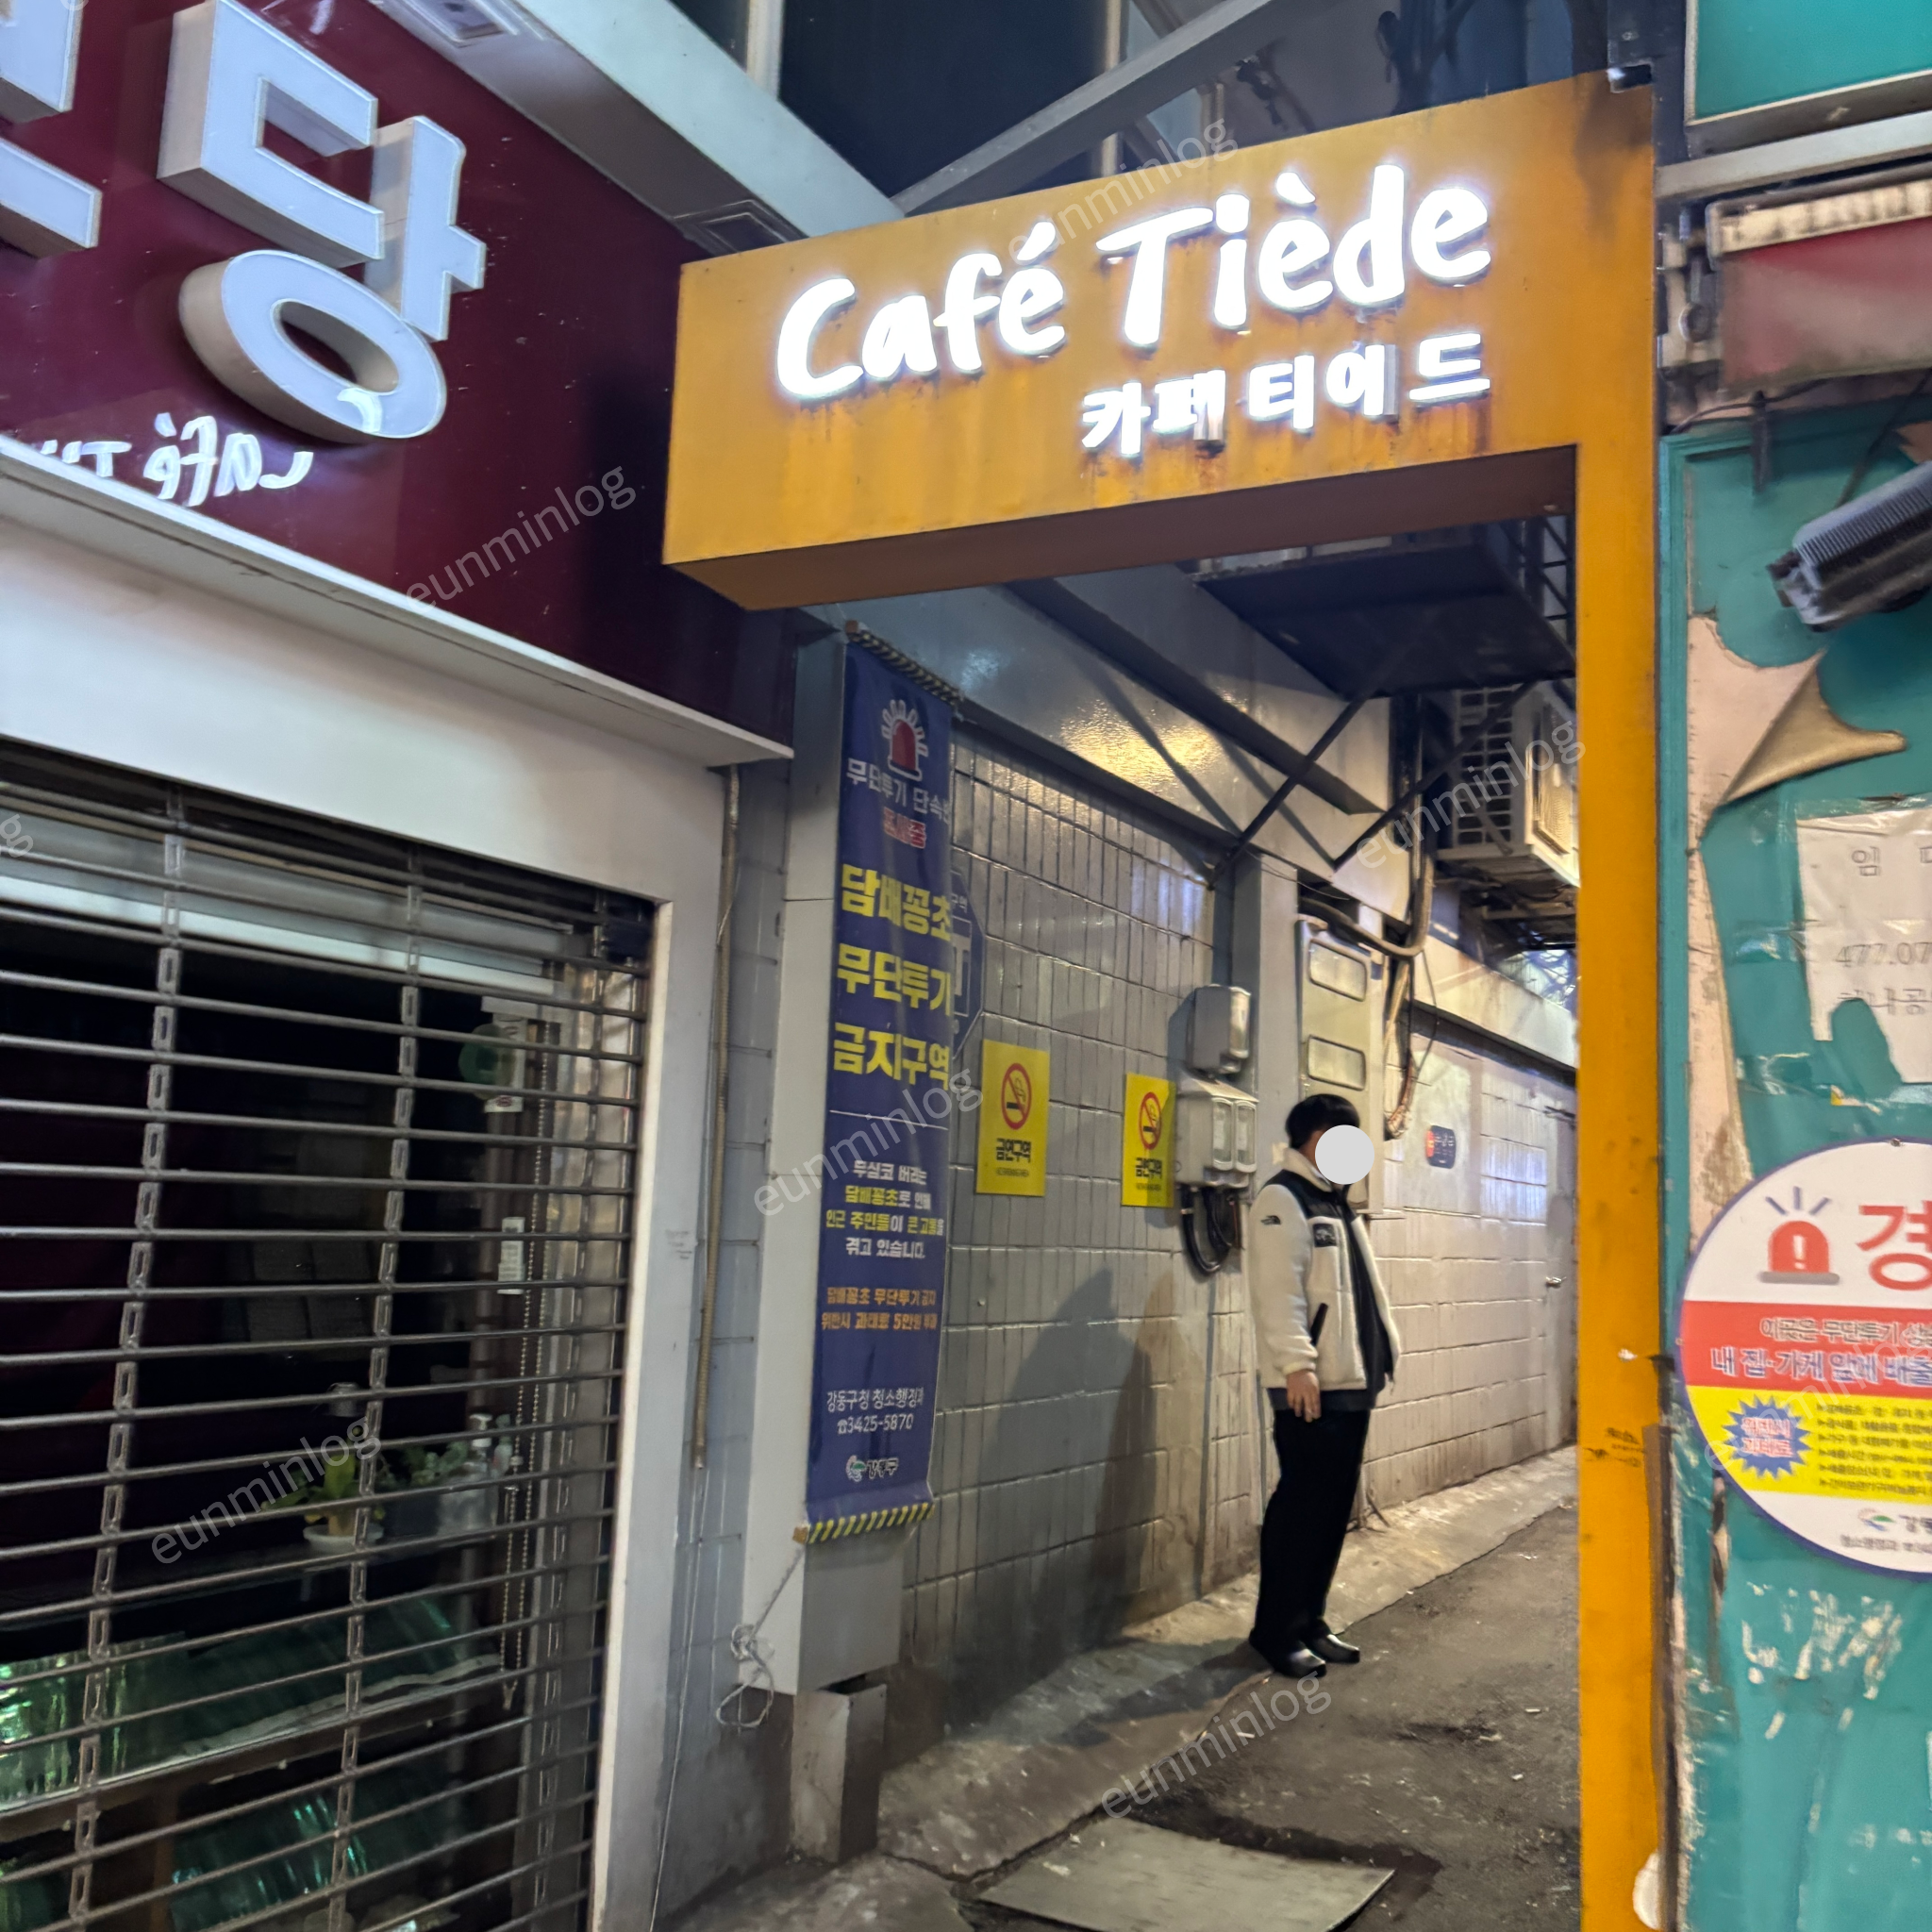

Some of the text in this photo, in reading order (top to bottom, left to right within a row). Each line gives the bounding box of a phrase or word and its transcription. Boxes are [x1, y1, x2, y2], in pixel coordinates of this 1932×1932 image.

[775, 163, 1491, 400] Café Tiède
[1081, 366, 1226, 458] 카페
[841, 864, 951, 941] 담배꽁초
[837, 943, 951, 1017] 무단투기
[833, 1022, 950, 1091] 금지구역
[826, 1390, 871, 1412] 강동구청
